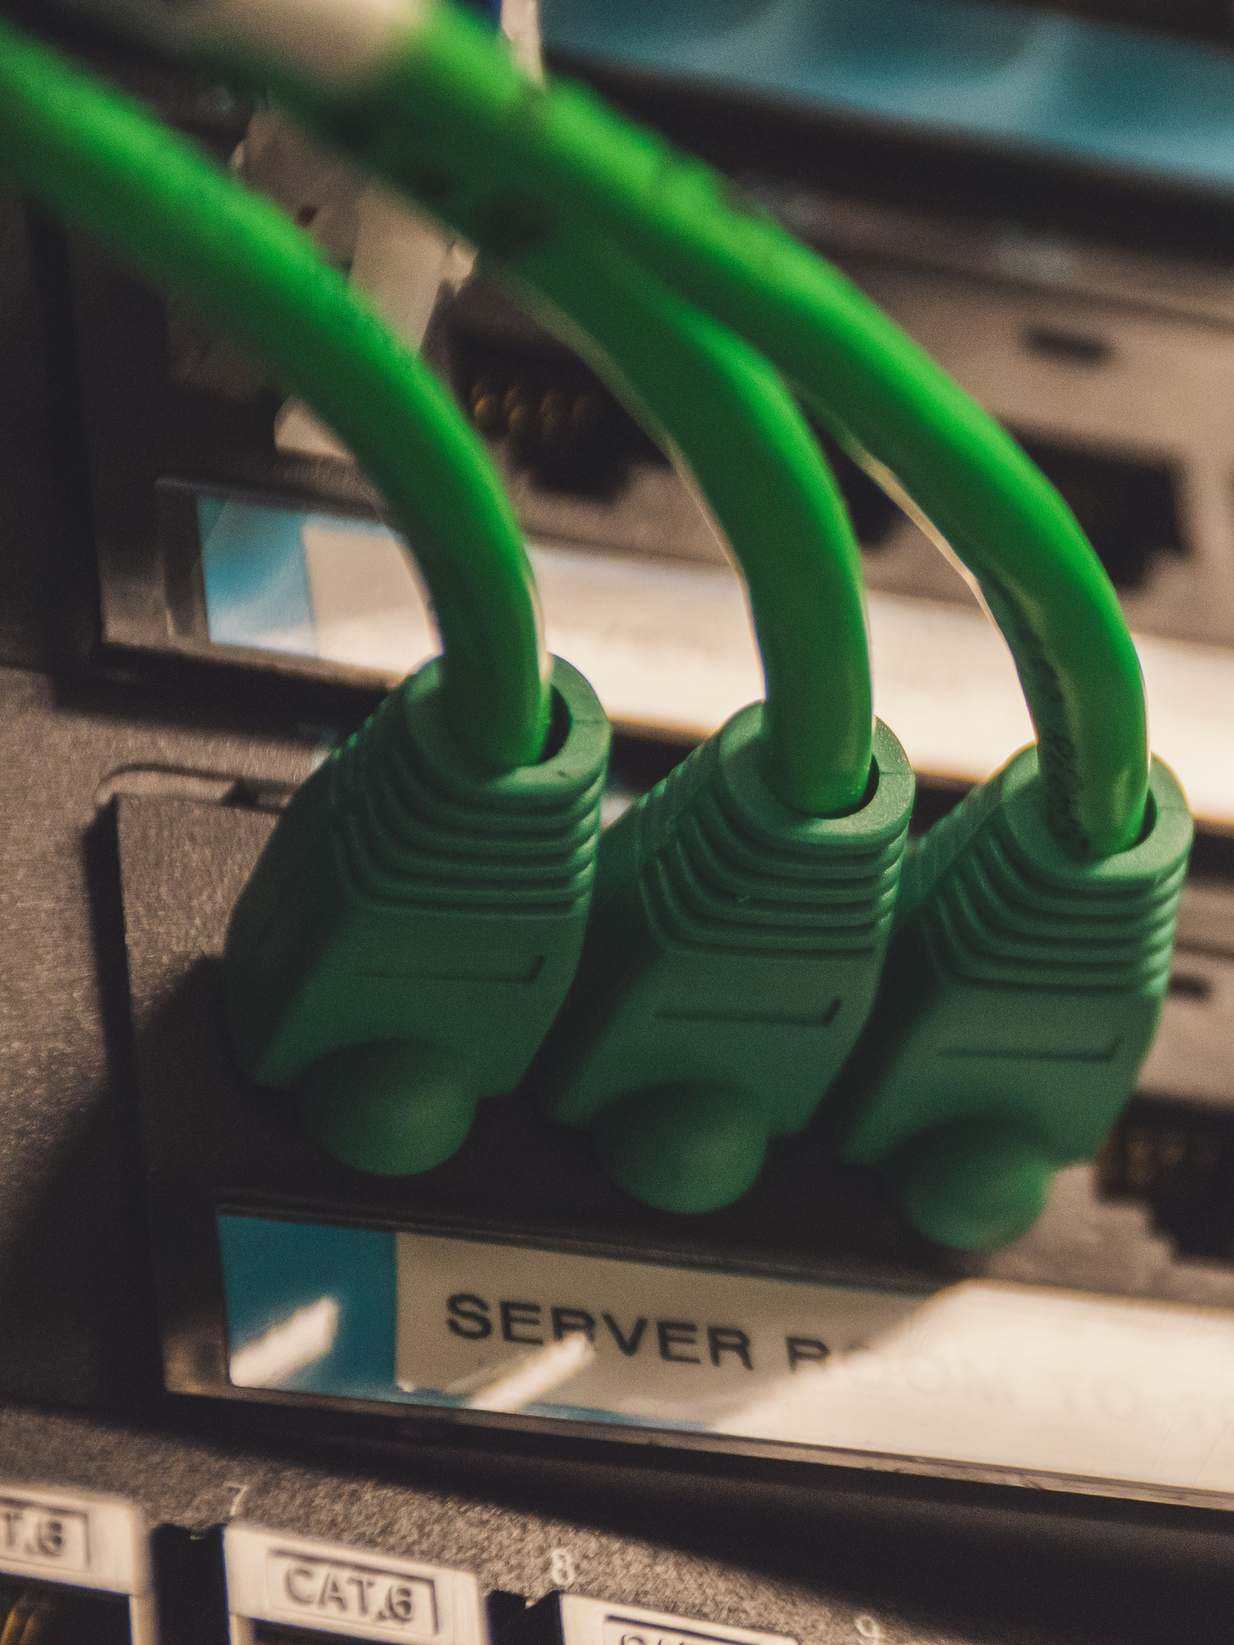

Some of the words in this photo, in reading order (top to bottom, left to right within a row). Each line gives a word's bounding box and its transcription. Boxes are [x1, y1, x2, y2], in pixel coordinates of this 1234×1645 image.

[446, 1293, 755, 1371] SERVER
[223, 1480, 248, 1516] 7
[551, 1550, 576, 1585] 8
[284, 1562, 414, 1625] CAT.6
